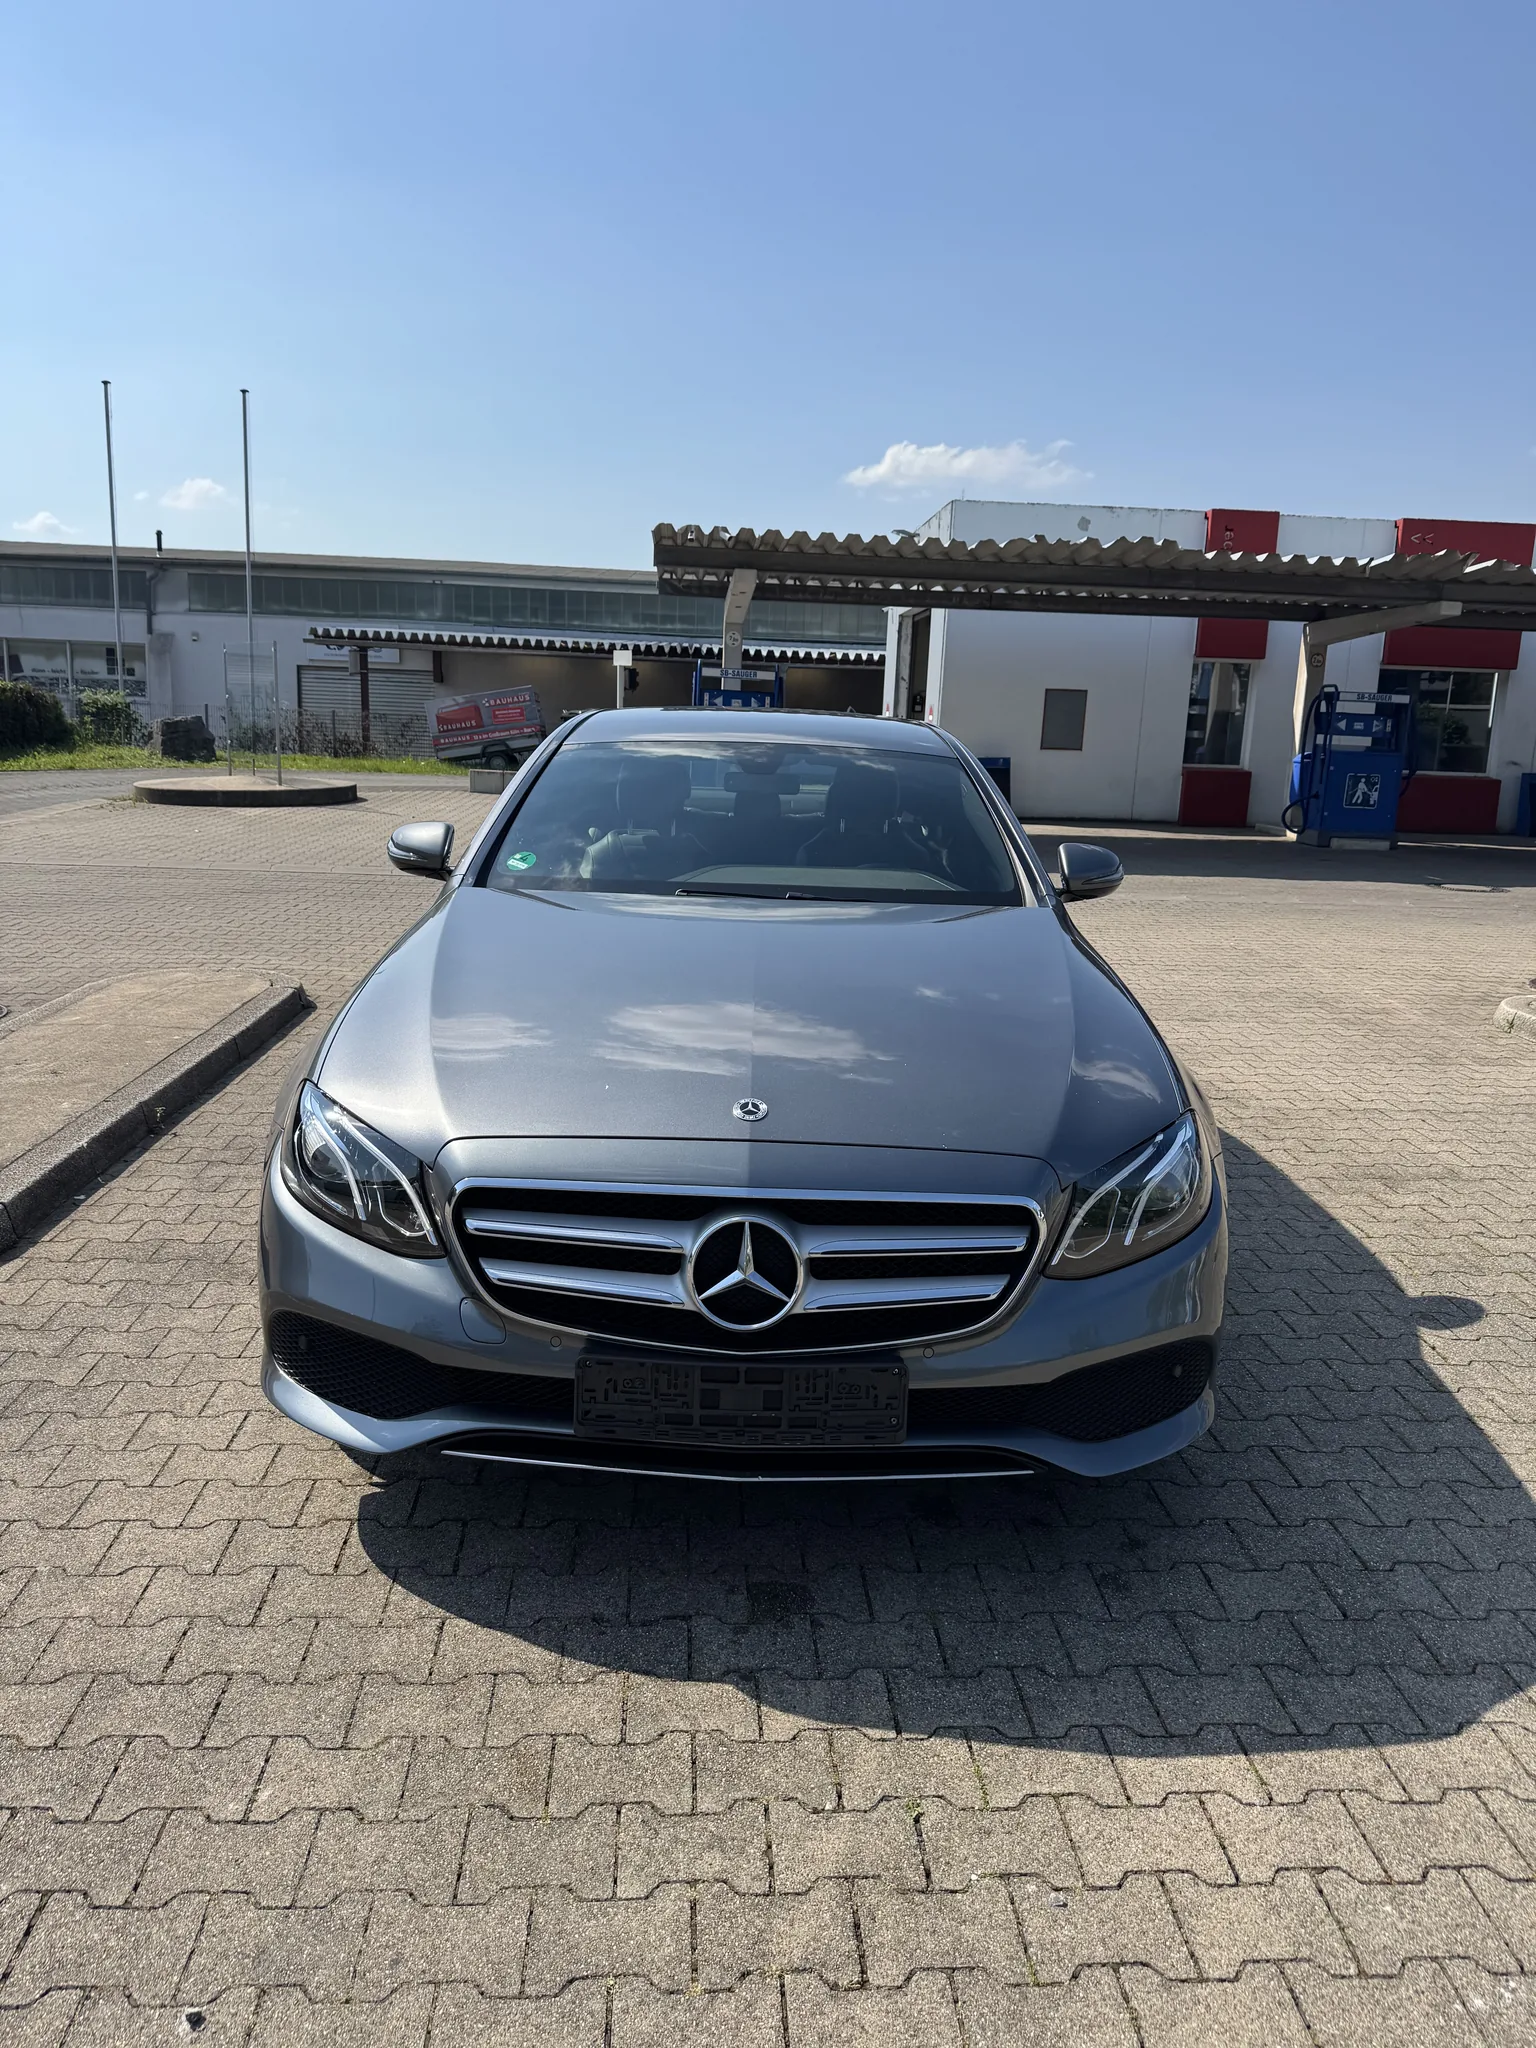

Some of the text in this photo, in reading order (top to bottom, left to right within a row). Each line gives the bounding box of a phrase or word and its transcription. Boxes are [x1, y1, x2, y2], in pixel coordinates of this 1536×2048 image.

[720, 669, 757, 678] SB-SAUGER
[489, 693, 530, 706] BAUHAUS
[1356, 693, 1392, 701] SB-SAUGER
[443, 719, 477, 730] BAUHAUS
[440, 735, 471, 744] BAUHAUS
[519, 853, 531, 862] 4
